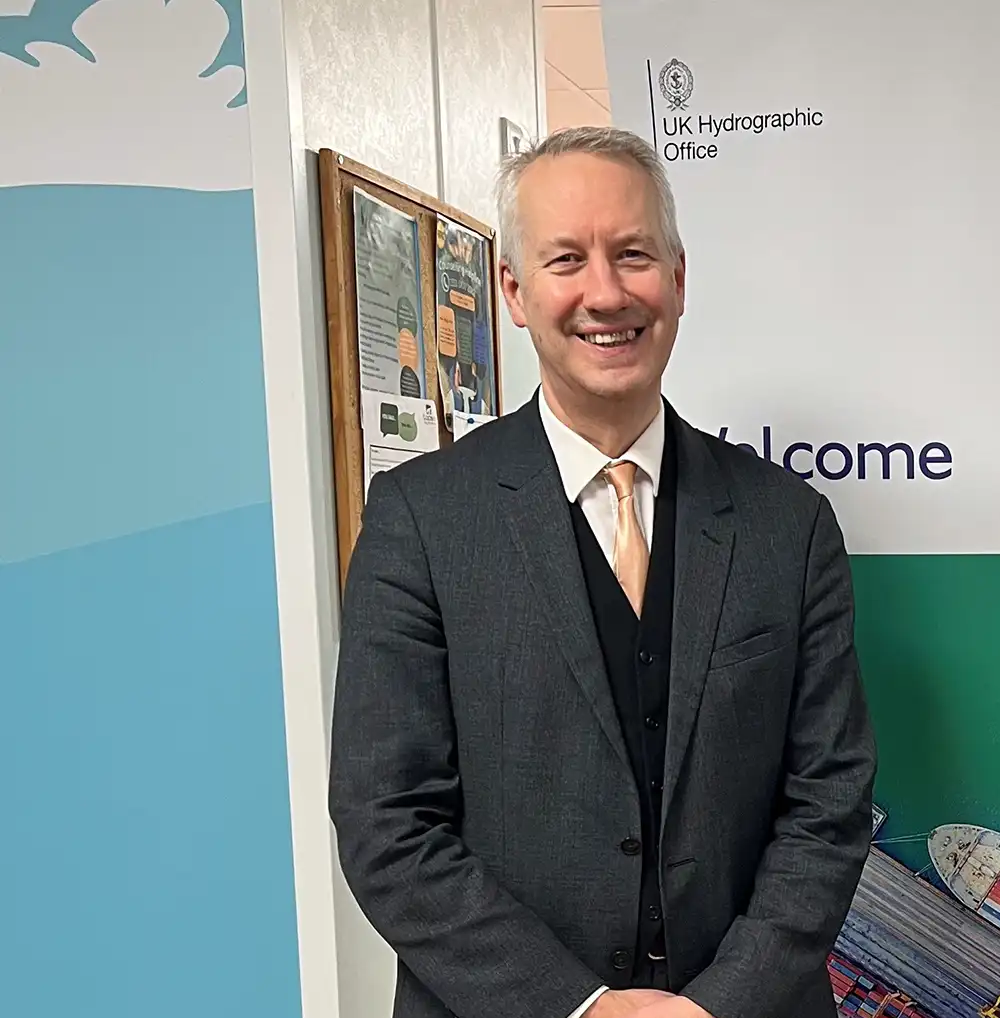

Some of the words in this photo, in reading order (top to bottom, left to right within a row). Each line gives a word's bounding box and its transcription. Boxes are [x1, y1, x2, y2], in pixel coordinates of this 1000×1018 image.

[663, 116, 693, 136] UK
[699, 107, 823, 138] Hydrographic
[663, 142, 719, 162] Office
[717, 425, 953, 480] lcome
